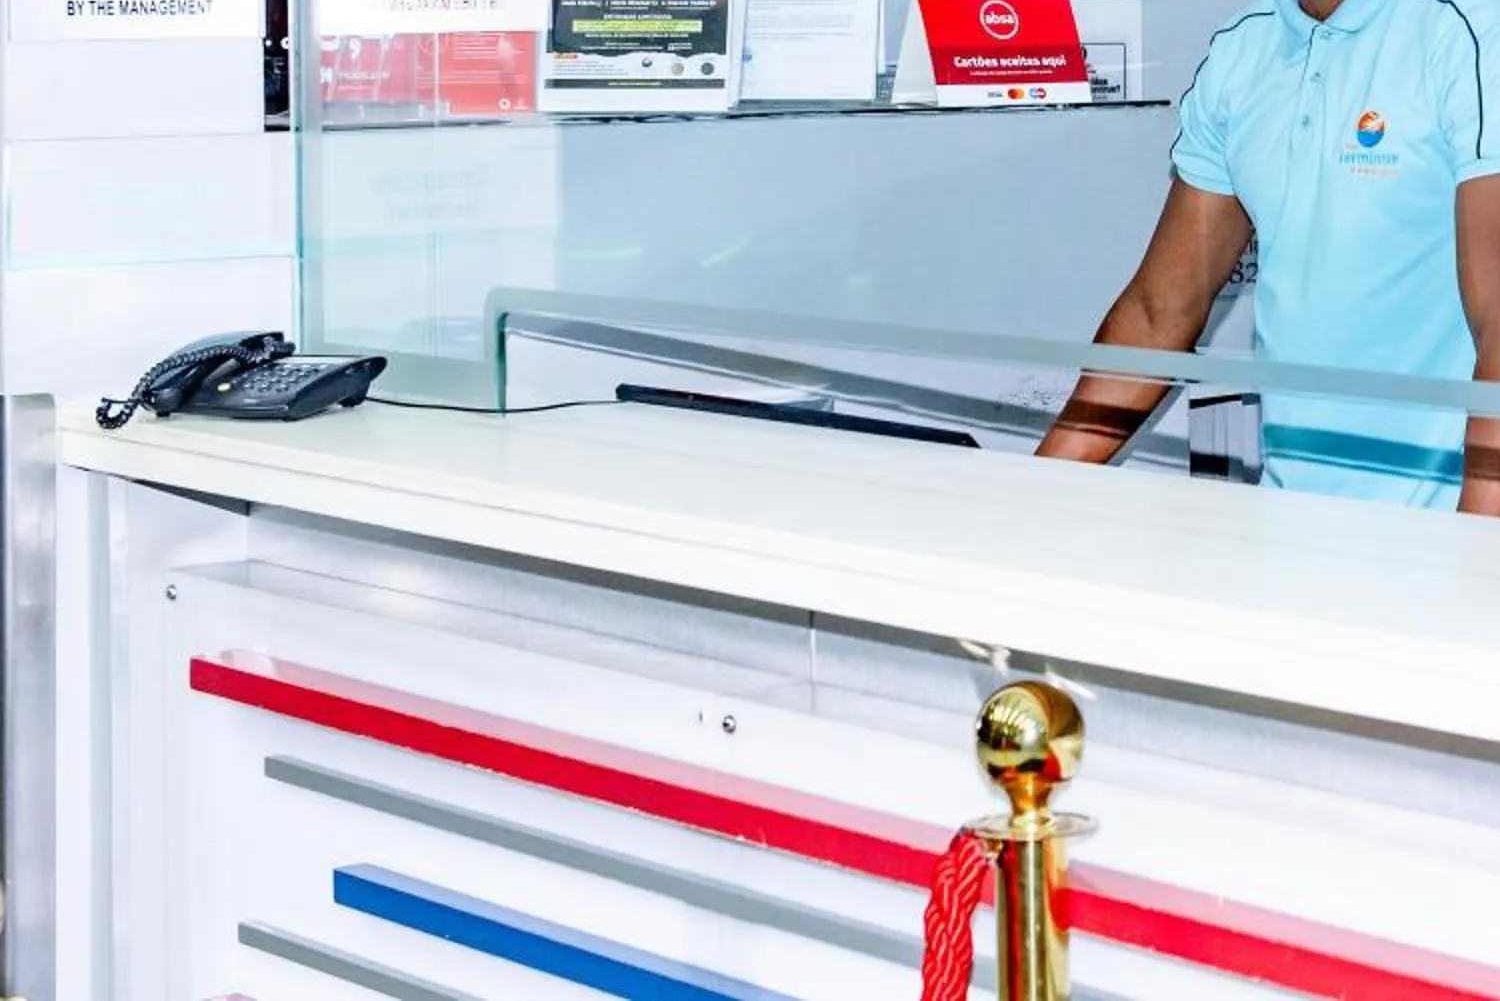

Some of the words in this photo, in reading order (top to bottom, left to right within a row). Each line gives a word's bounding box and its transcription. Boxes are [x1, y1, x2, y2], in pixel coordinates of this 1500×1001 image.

[67, 0, 85, 16] BY
[89, 0, 115, 16] THE
[119, 0, 213, 16] MANAGEMENT
[985, 10, 1016, 25] absa
